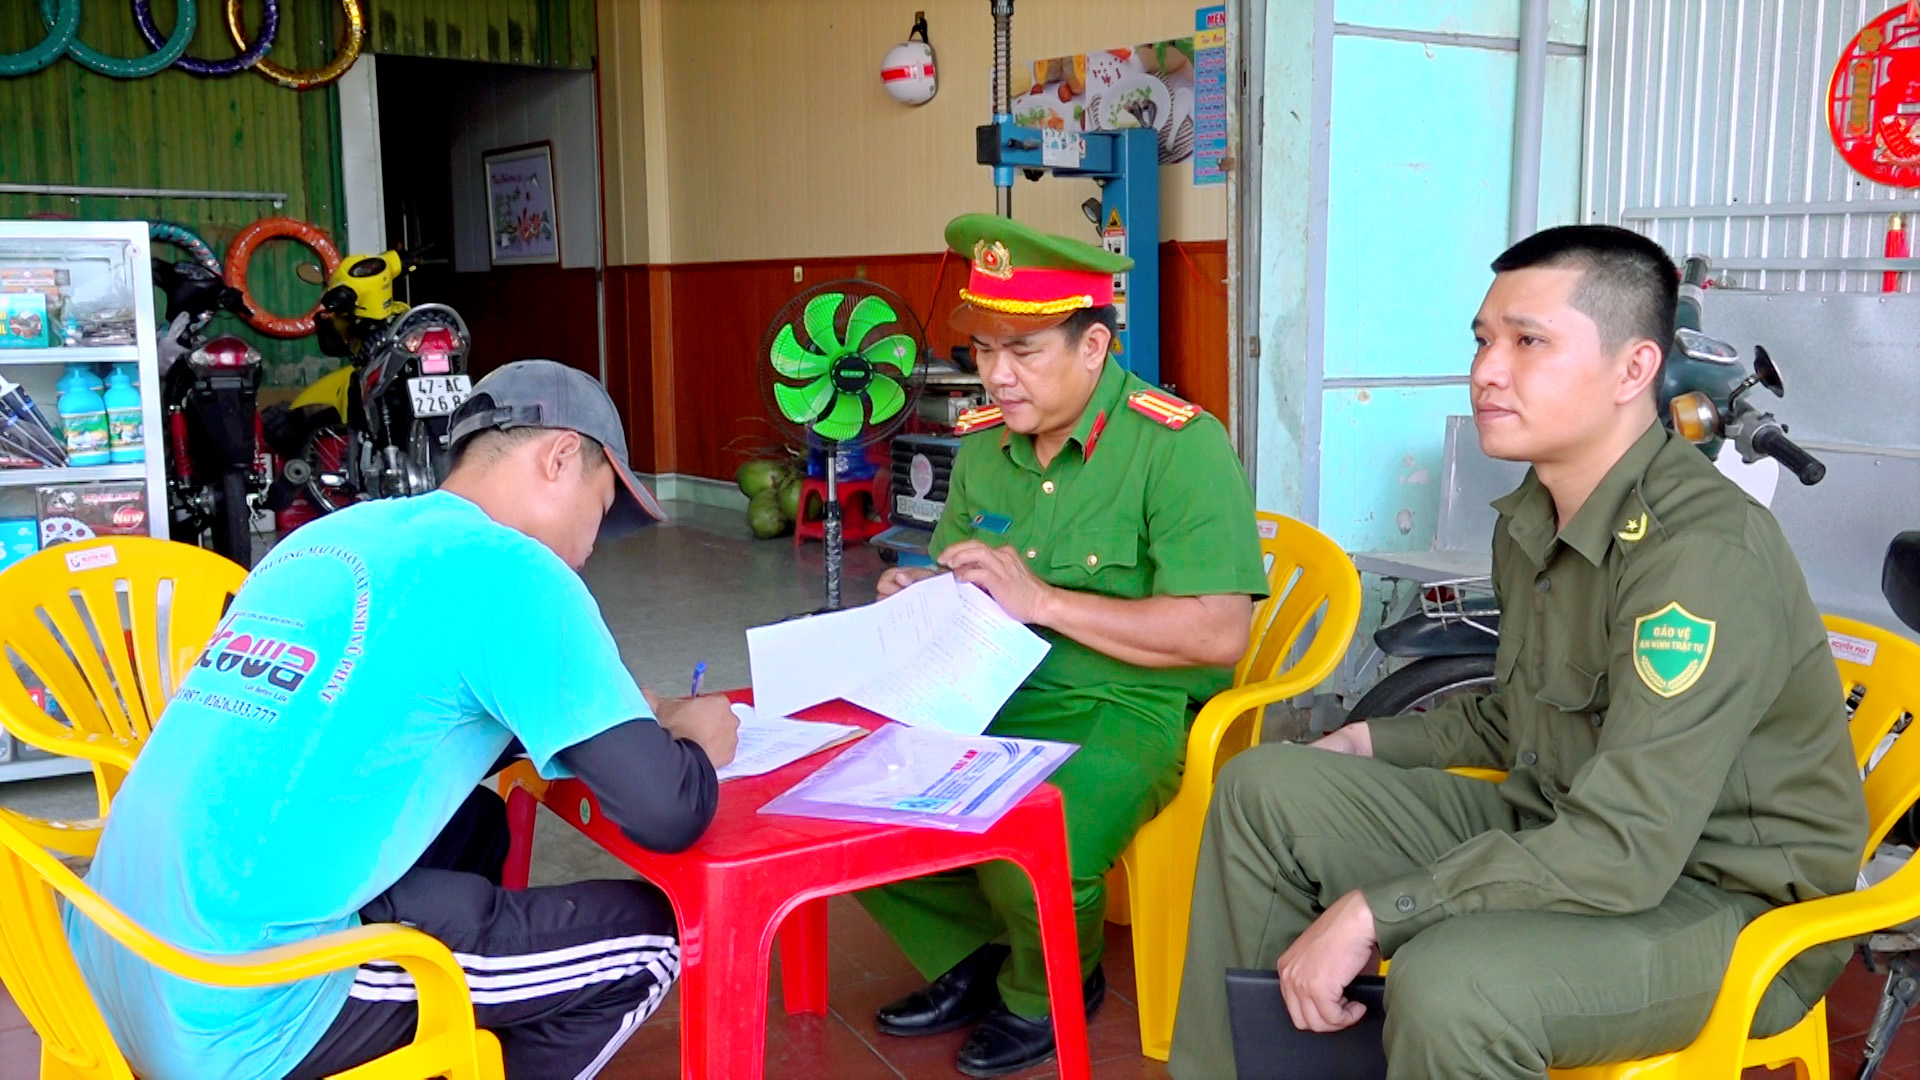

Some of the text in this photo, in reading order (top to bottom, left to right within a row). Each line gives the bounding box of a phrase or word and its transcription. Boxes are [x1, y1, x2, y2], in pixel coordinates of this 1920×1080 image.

[418, 377, 463, 394] 47-AC
[1653, 623, 1691, 640] BẢO VỆ
[1640, 639, 1650, 649] AN
[1651, 640, 1671, 650] NINH
